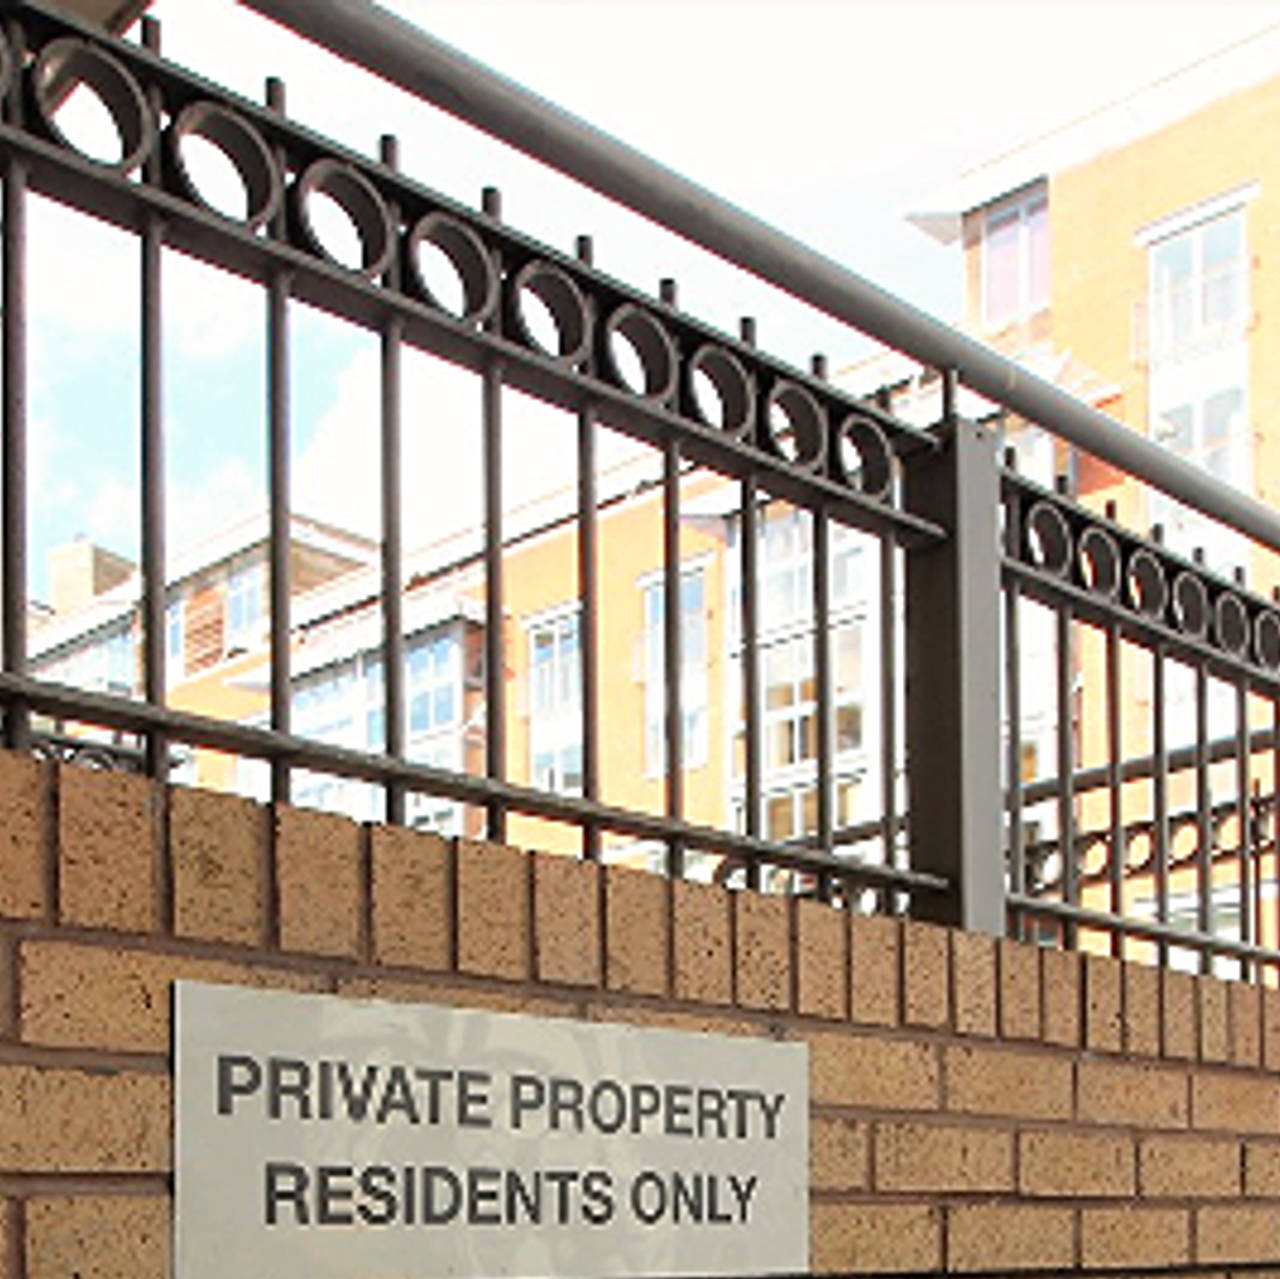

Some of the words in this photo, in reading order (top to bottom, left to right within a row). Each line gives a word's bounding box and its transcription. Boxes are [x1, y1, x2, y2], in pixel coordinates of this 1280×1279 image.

[217, 1054, 492, 1128] PRIVATE
[511, 1074, 786, 1140] PROPERTY
[264, 1162, 615, 1226] RESIDENTS
[630, 1171, 758, 1225] ONLY
